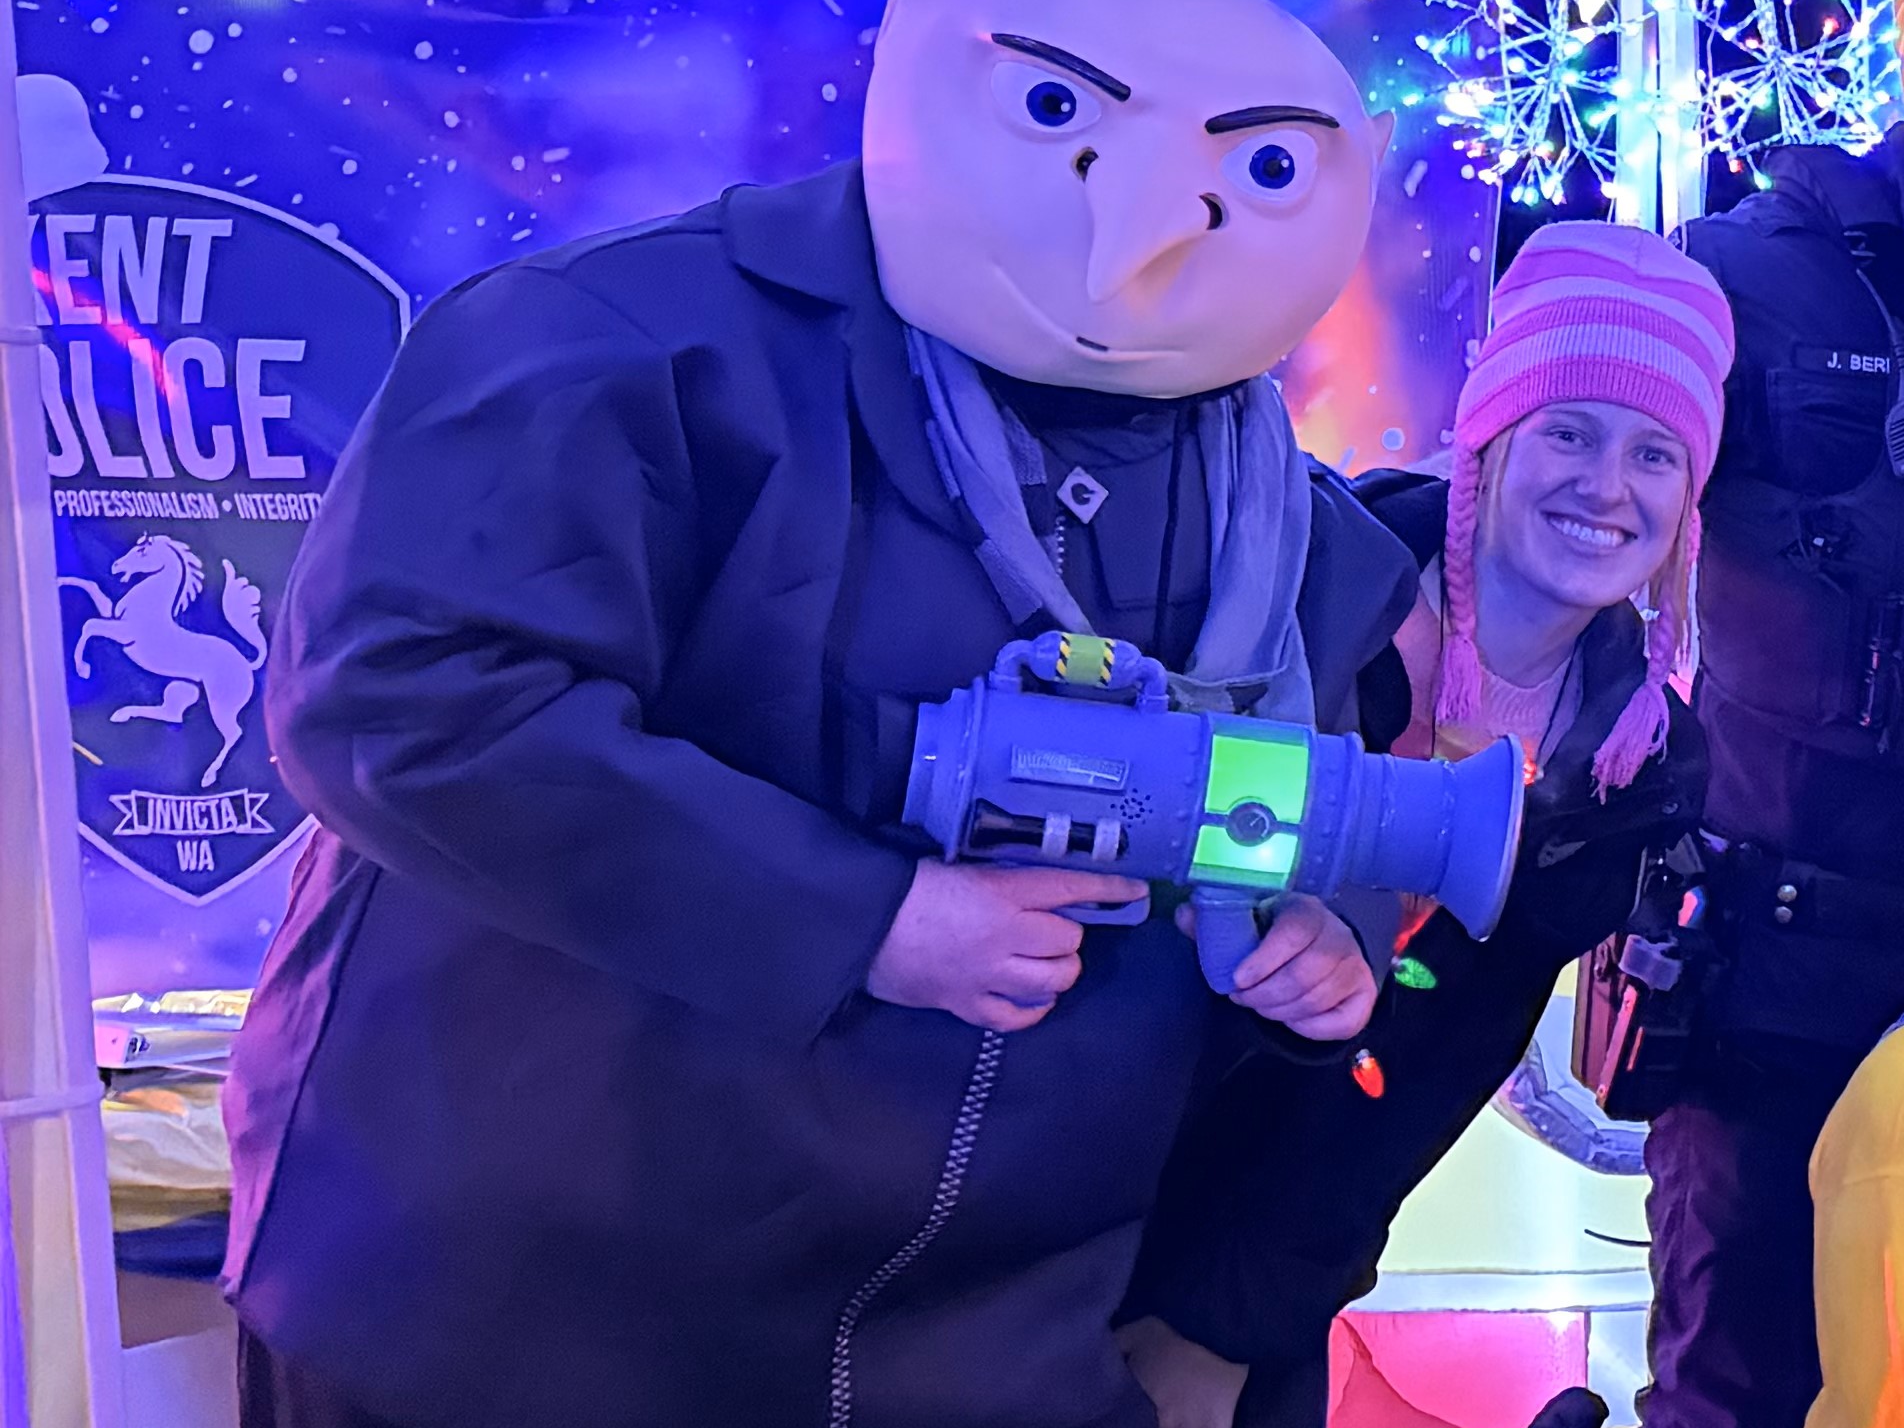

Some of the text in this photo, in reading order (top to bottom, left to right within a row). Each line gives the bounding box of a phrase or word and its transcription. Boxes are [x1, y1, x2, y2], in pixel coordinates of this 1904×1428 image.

[40, 336, 306, 481] OLICE
[54, 488, 219, 520] PROFESSIONALISM
[148, 797, 238, 832] INVICTA
[176, 839, 215, 872] WA
